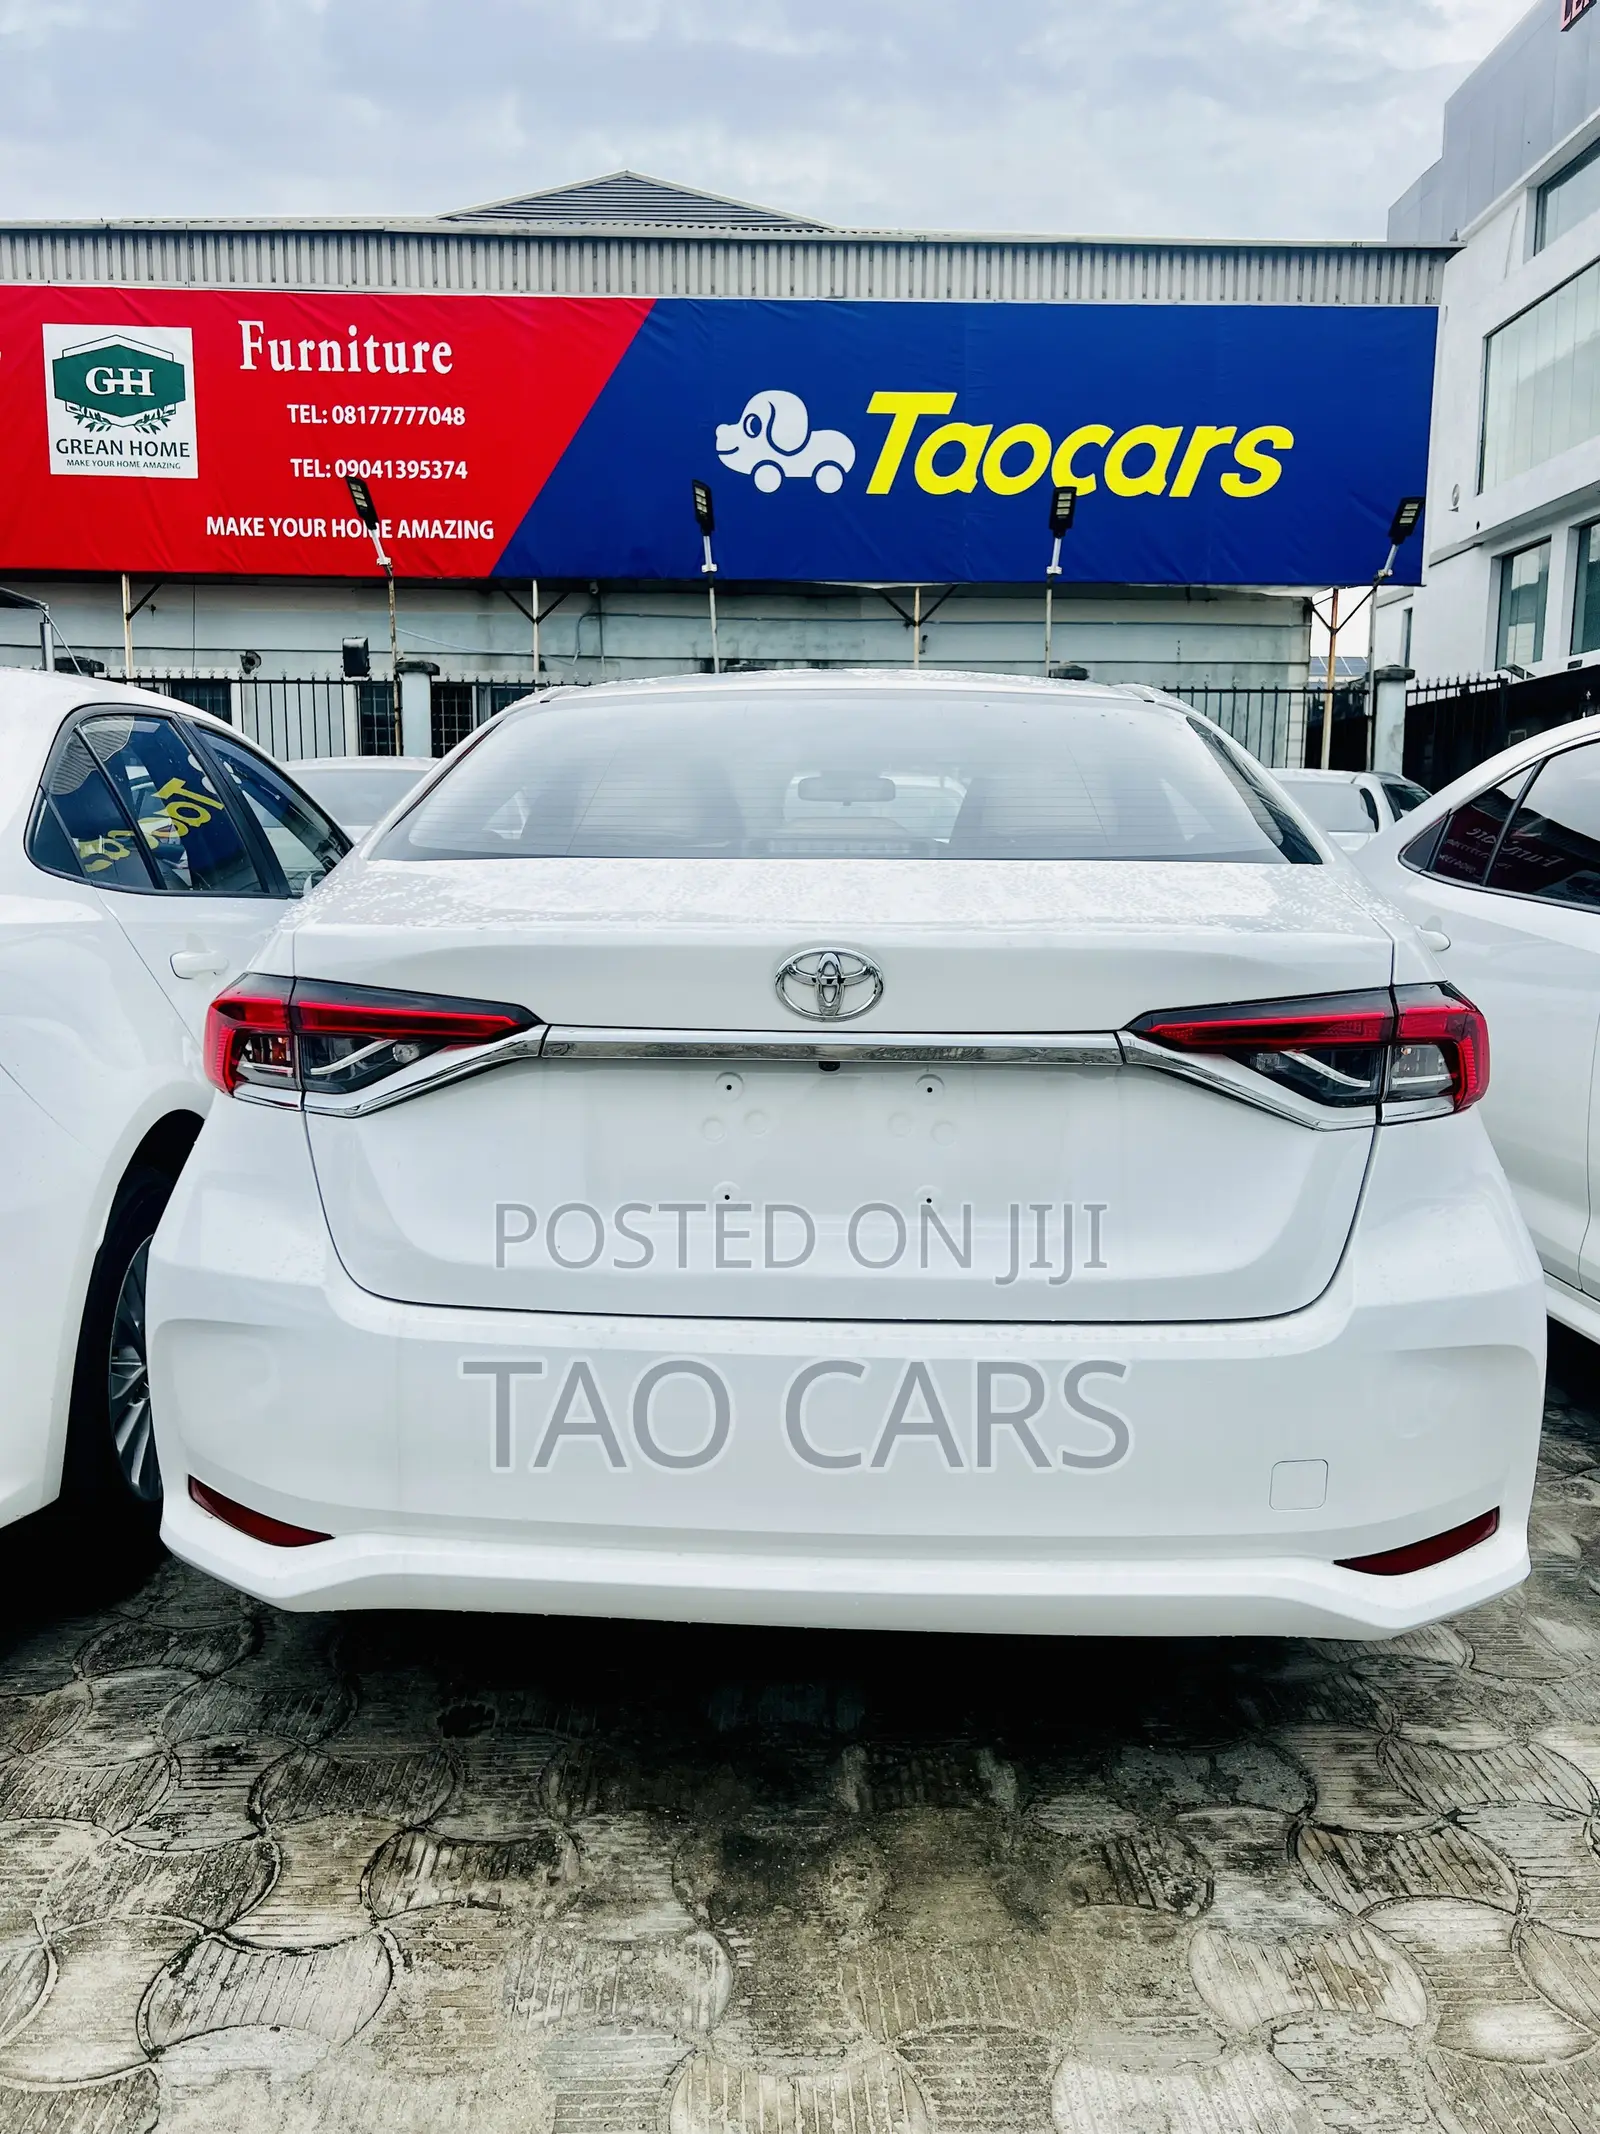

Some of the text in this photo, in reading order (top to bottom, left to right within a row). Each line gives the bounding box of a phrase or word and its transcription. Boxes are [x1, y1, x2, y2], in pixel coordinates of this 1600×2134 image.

[237, 320, 454, 375] Furniture
[85, 366, 156, 397] GH
[286, 404, 466, 426] TEL: 08177777048
[55, 438, 191, 458] GREAN HOME
[866, 390, 1294, 498] Taocars
[66, 459, 89, 467] MAKE
[142, 461, 181, 469] AMAZING
[289, 458, 468, 480] TEL: 09041395374
[206, 516, 265, 537] MAKE
[268, 517, 327, 538] YOUR
[397, 519, 495, 540] AMAZING
